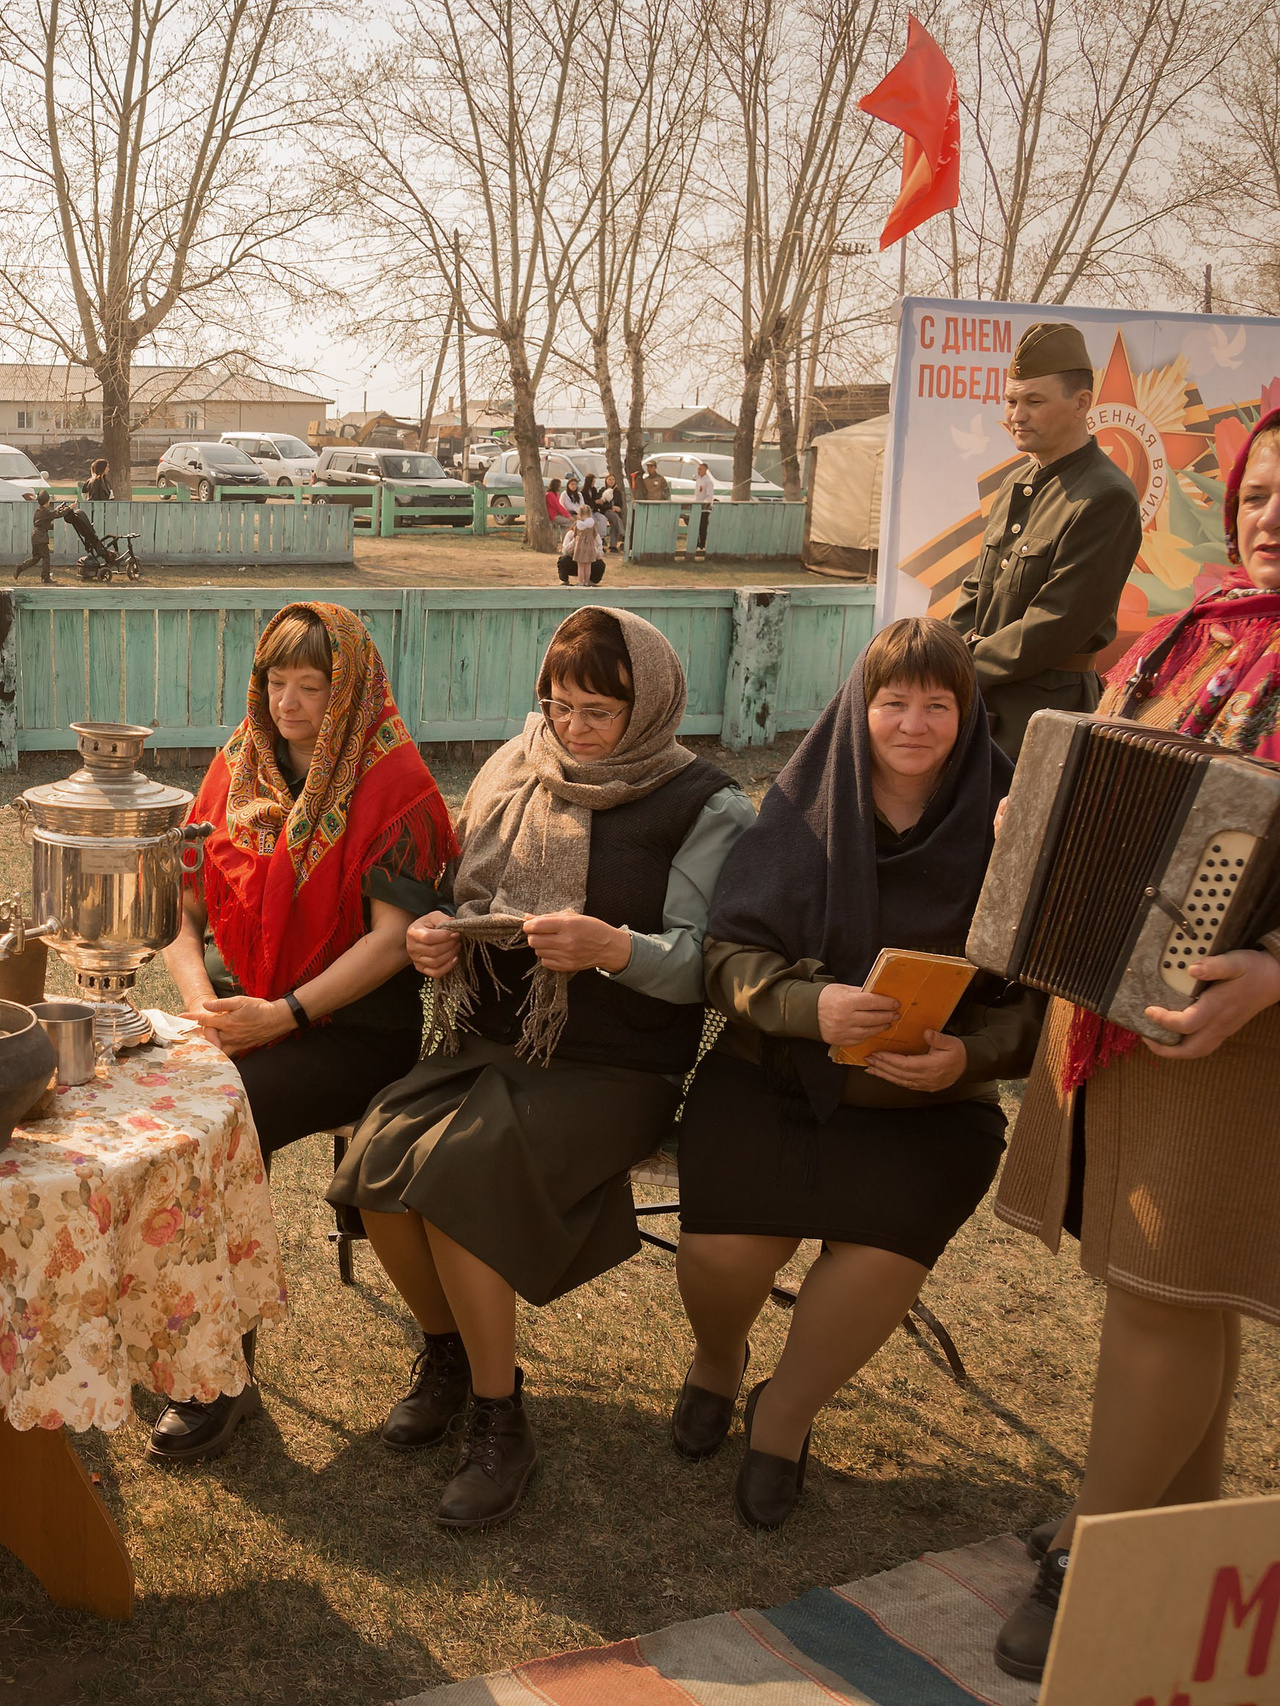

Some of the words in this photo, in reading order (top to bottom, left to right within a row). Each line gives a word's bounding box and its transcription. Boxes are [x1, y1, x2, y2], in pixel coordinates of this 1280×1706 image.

[920, 315, 935, 349] С
[942, 317, 1012, 355] ДНЕМ
[1086, 409, 1157, 448] ВЕННАЯ
[1141, 458, 1164, 522] ВОЙН
